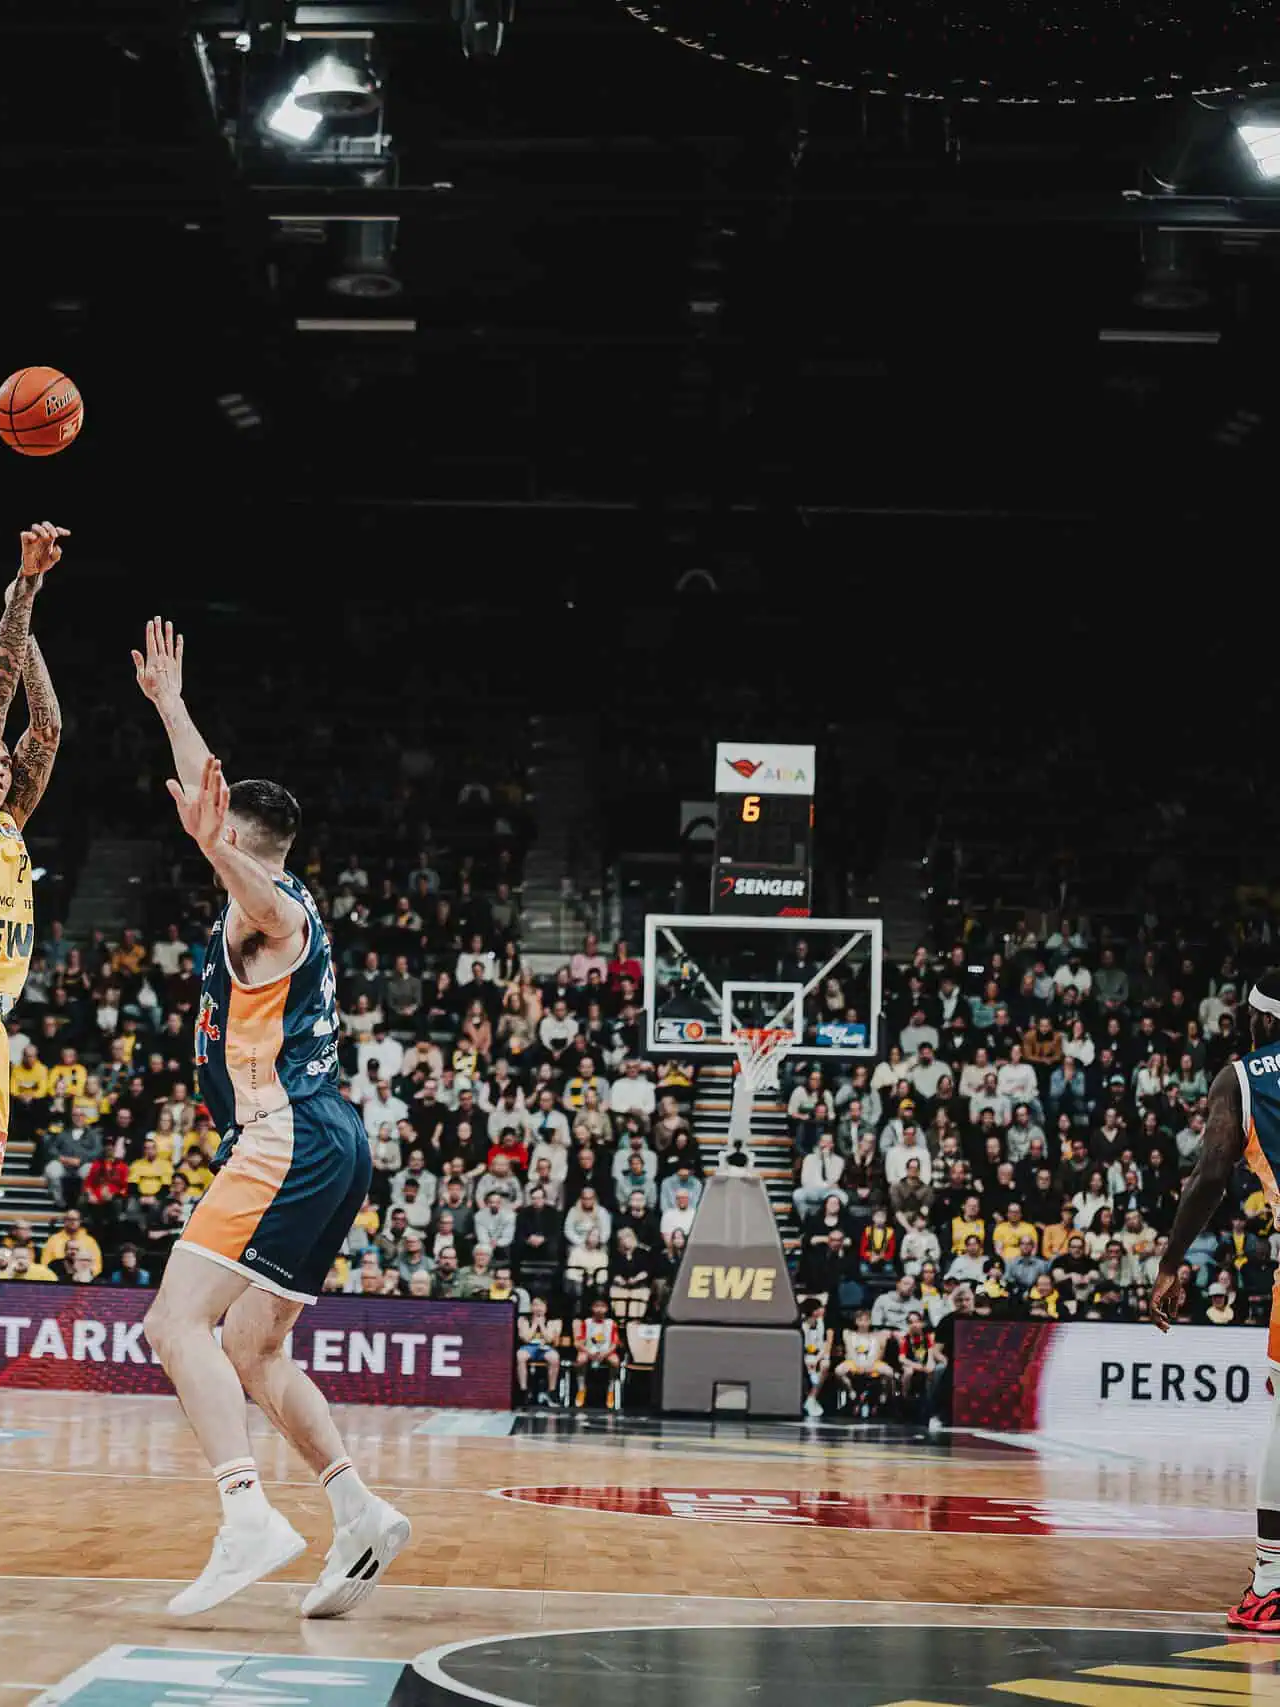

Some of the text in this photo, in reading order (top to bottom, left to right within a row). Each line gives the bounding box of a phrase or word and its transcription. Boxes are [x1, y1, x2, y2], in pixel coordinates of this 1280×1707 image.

[763, 767, 807, 785] AIDA
[742, 795, 761, 822] 6
[734, 877, 806, 896] SENGER
[687, 1265, 776, 1301] EWE
[283, 1329, 463, 1377] LENTE
[1100, 1361, 1250, 1404] PERSO
